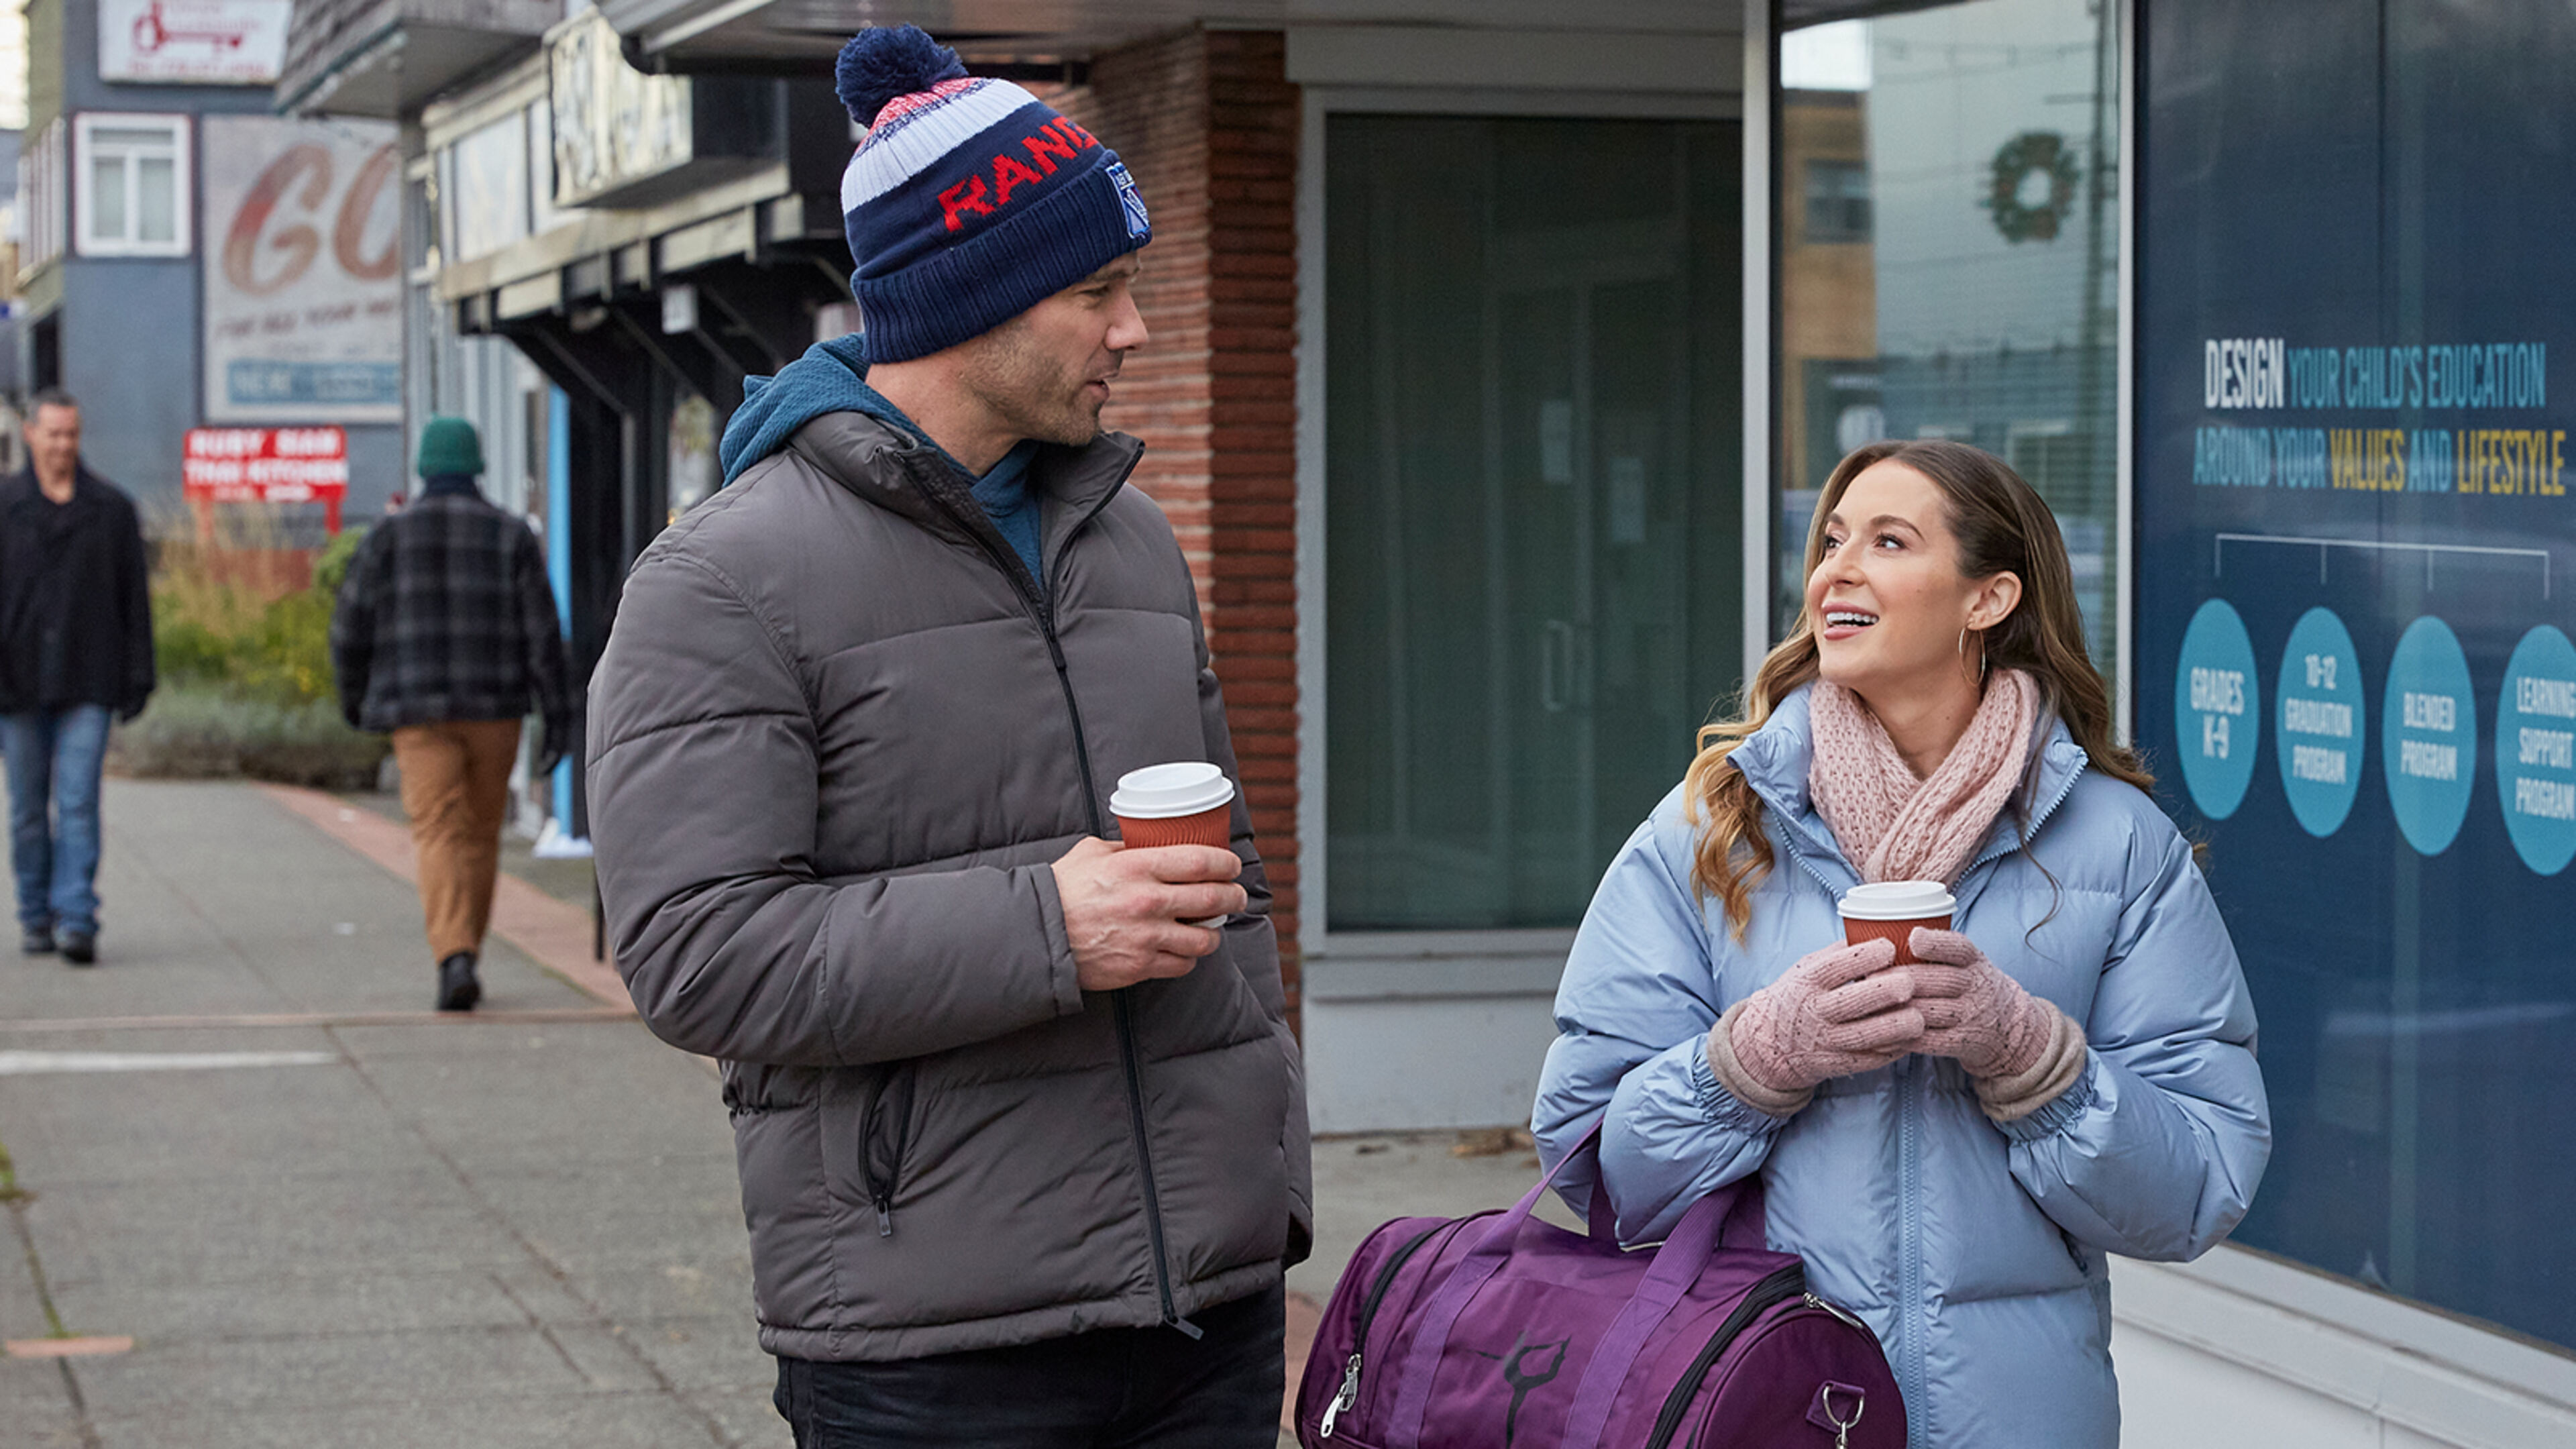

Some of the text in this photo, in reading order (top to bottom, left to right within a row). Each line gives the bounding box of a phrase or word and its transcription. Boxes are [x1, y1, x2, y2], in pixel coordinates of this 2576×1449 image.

[2205, 337, 2546, 409] DESIGN YOUR CHILD'S EDUCATION
[2194, 427, 2566, 496] AROUND YOUR VALUES AND LIFESTYLE
[2190, 666, 2245, 715] GRADES
[2305, 654, 2337, 690] 10-12
[2285, 697, 2352, 738] GRADUATION
[2404, 692, 2456, 732] BLENDED
[2517, 677, 2576, 718] LEARNING
[2203, 714, 2230, 759] K-9
[2519, 727, 2573, 769] SUPPORT
[2293, 745, 2347, 785] PROGRAM
[2401, 739, 2457, 782] PROGRAM
[2516, 777, 2575, 820] PROGRAM
